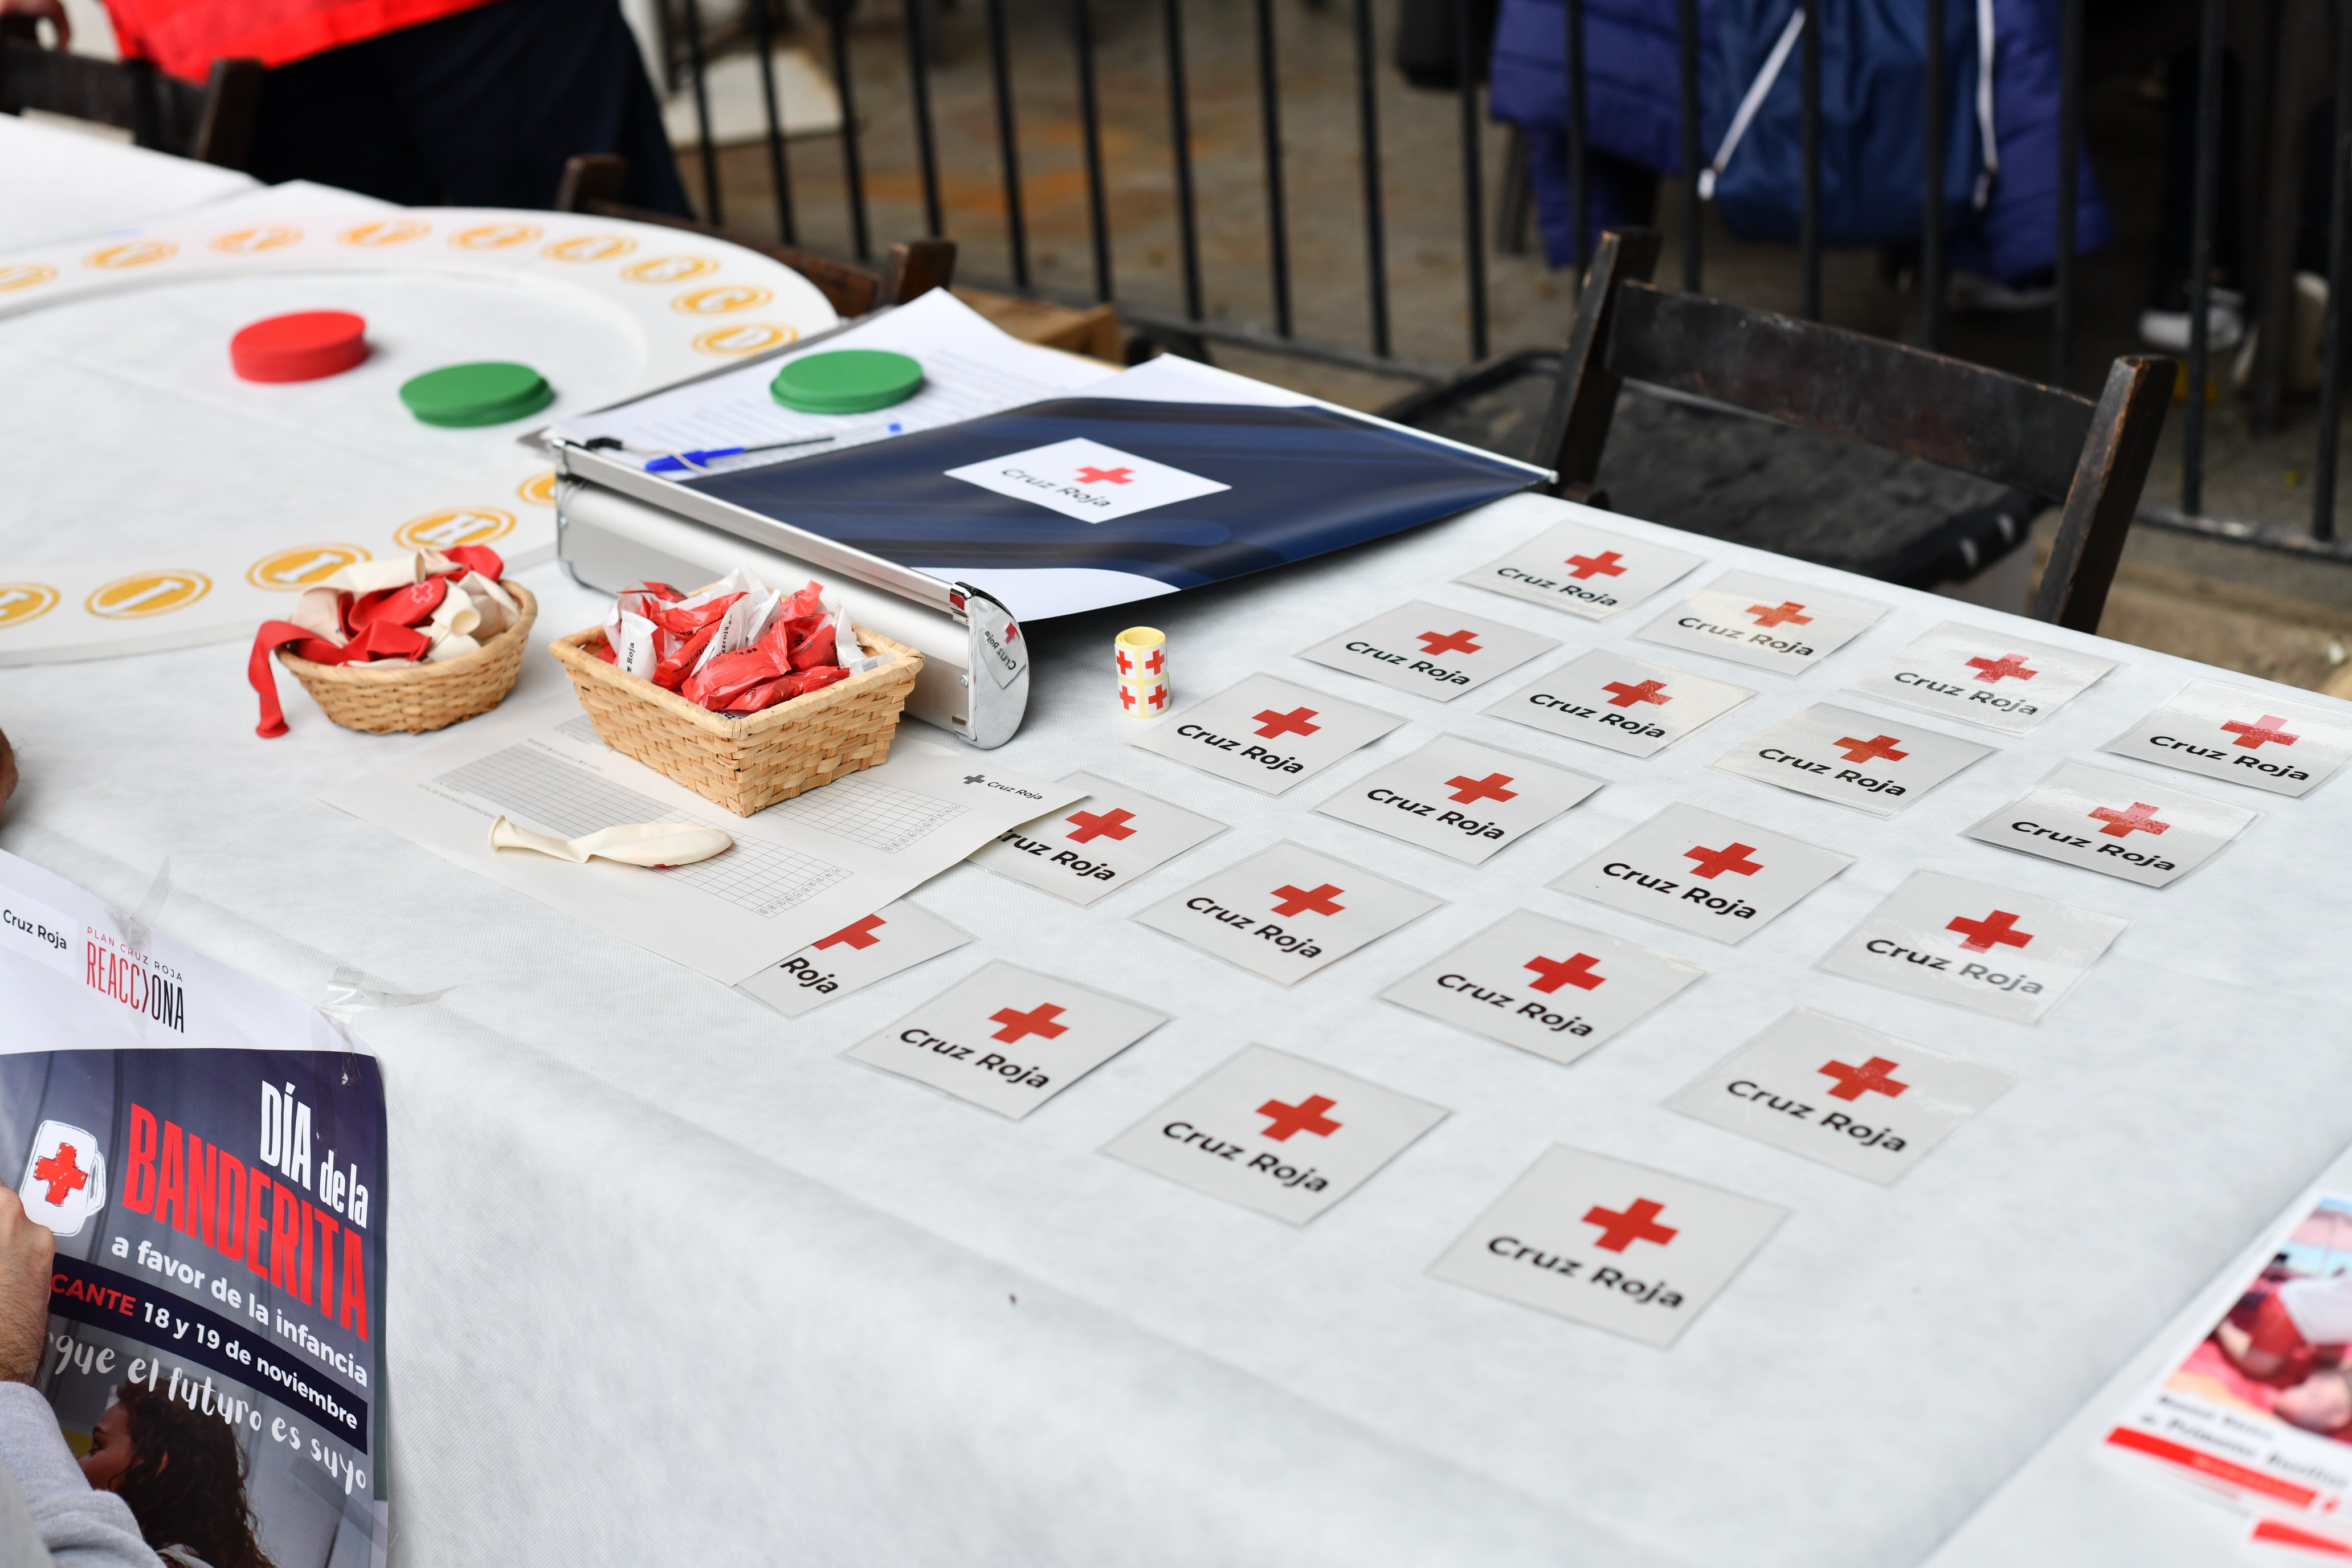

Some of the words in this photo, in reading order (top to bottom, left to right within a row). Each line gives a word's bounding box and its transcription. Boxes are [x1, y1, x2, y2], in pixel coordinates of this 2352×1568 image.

[1002, 469, 1056, 488] Cruz
[1056, 487, 1110, 507] Roja
[412, 512, 501, 545] H
[1497, 568, 1557, 589] Cruz
[1559, 585, 1618, 606] Roja
[1677, 617, 1744, 639] Cruz
[1749, 634, 1814, 656] Roja
[1346, 642, 1408, 665] Cruz
[1408, 661, 1470, 685] Roja
[1529, 695, 1597, 718] Cruz
[1598, 713, 1665, 738] Roja
[1894, 673, 1965, 696] Cruz
[1969, 690, 2039, 716] Roja
[1177, 725, 1241, 752] Cruz
[1240, 746, 1303, 773] Roja
[1759, 749, 1832, 774] Cruz
[1834, 770, 1906, 796] Roja
[2150, 736, 2228, 760] Cruz
[2233, 756, 2309, 780] Roja
[987, 782, 1016, 792] Cruz
[1015, 789, 1043, 799] Roja
[1367, 789, 1436, 816] Cruz
[1436, 811, 1504, 839] Roja
[996, 829, 1052, 856] ruz
[1050, 851, 1115, 880] Roja
[2011, 822, 2092, 848] Cruz
[2096, 844, 2175, 871] Roja
[1603, 863, 1679, 893] Cruz
[1681, 887, 1756, 919] Roja
[3, 909, 33, 934] Cruz
[38, 924, 67, 950] Roja
[1187, 898, 1255, 929] Cruz
[1253, 925, 1321, 958] Roja
[87, 926, 115, 947] PLAN
[120, 943, 148, 965] CRUZ
[154, 960, 183, 982] ROJA
[779, 957, 838, 994] Roja
[1867, 940, 1951, 970] Cruz
[1959, 963, 2042, 994] Roja
[1438, 975, 1514, 1007] Cruz
[1517, 1002, 1593, 1036] Roja
[900, 1030, 974, 1060] Cruz
[975, 1054, 1049, 1088] Roja
[1728, 1081, 1814, 1118] Cruz
[1820, 1112, 1906, 1152] Roja
[260, 1080, 311, 1191] DÍA
[319, 1149, 346, 1214] de
[348, 1163, 369, 1229] la
[1163, 1122, 1244, 1160] Cruz
[1248, 1153, 1328, 1192] Roja
[122, 1102, 369, 1342] BANDERITA
[1488, 1237, 1582, 1276] Cruz
[1591, 1267, 1685, 1309] Roja
[112, 1237, 129, 1257] a
[137, 1240, 206, 1289] favor
[211, 1277, 242, 1309] de
[248, 1292, 269, 1326] la
[276, 1309, 368, 1388] infancia
[144, 1302, 170, 1329] 18
[172, 1318, 190, 1339] y
[196, 1322, 220, 1349] 19
[225, 1340, 252, 1366] de
[256, 1355, 358, 1430] noviembre
[48, 1332, 115, 1374] gue
[127, 1357, 158, 1393] el
[168, 1367, 262, 1431] futuro
[271, 1416, 301, 1450] es
[310, 1437, 366, 1496] suyo
